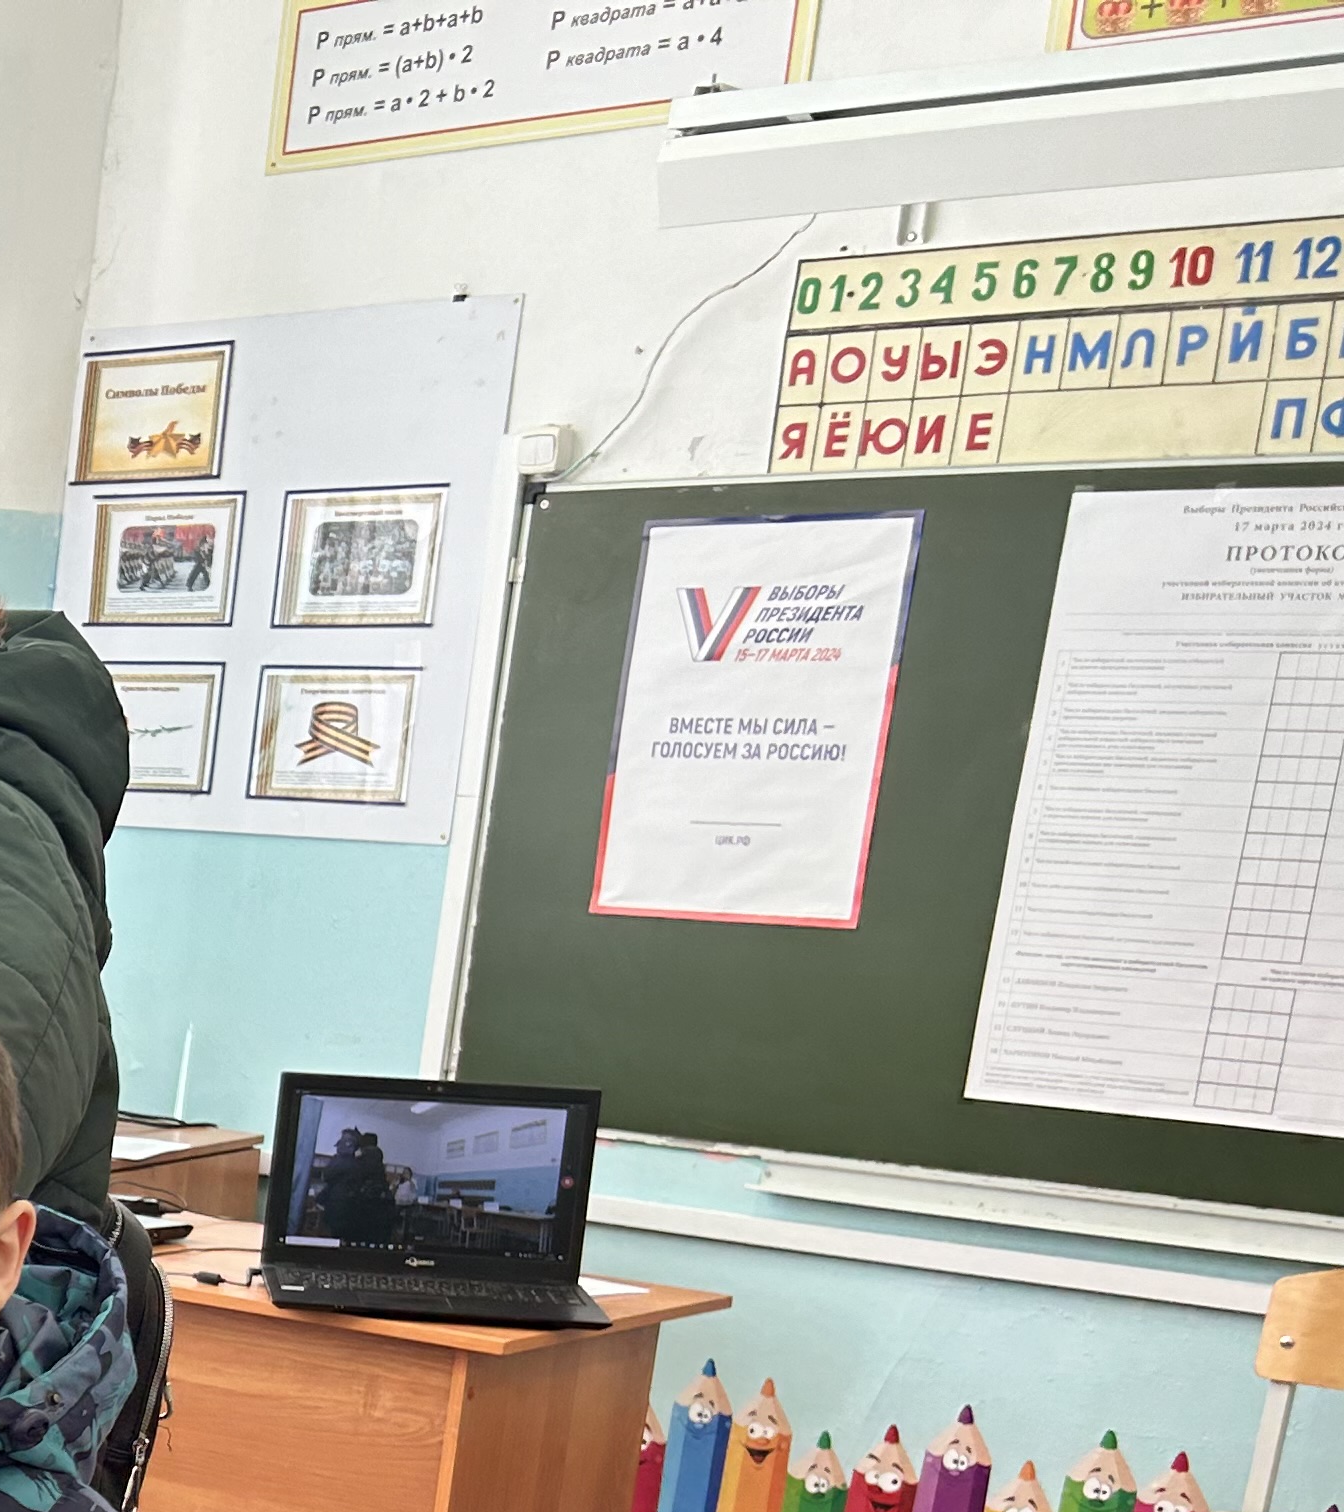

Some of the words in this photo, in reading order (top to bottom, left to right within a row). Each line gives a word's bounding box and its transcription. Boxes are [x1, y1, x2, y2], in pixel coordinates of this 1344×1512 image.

[570, 2, 657, 28] квадрата
[333, 30, 377, 50] прям.
[565, 41, 652, 67] квадрата
[709, 26, 724, 46] 4
[329, 67, 373, 87] прям.
[461, 44, 474, 64] 2
[325, 104, 368, 124] прям.
[418, 88, 430, 108] 2
[483, 78, 495, 98] 2
[796, 277, 822, 315] 0
[829, 274, 847, 312] 1
[858, 271, 883, 311] 2
[895, 268, 922, 308] 3
[930, 264, 957, 304] 4
[971, 261, 1000, 301] 5
[1012, 259, 1040, 299] 6
[1053, 255, 1078, 296] 7
[1090, 252, 1115, 293] 8
[1127, 249, 1155, 291] 9
[1169, 245, 1215, 288] 10
[1235, 240, 1275, 284] 11
[1292, 235, 1343, 280] 12
[788, 348, 817, 386] А
[830, 346, 866, 384] О
[881, 344, 911, 382] У
[919, 340, 962, 381] Ы
[974, 338, 1008, 376] Э
[1022, 334, 1056, 375] Н
[1067, 330, 1113, 372] М
[1120, 328, 1156, 369] Л
[1175, 324, 1209, 367] Р
[1227, 305, 1264, 364] Й
[1285, 317, 1320, 361] Б
[778, 421, 808, 460] Я
[823, 411, 852, 458] Ё
[858, 417, 909, 457] Ю
[913, 414, 947, 454] И
[964, 412, 994, 451] Е
[1269, 397, 1308, 440] П
[767, 584, 847, 602] ВЫБОРЫ
[755, 605, 865, 624] ПРЕЗИДЕНТА
[742, 627, 815, 644] РОССИИ
[768, 648, 812, 662] МАРТА
[812, 647, 842, 662] 2024
[669, 717, 734, 735] ВМЕСТЕ
[737, 717, 768, 735] МЫ
[772, 718, 818, 735] СИЛА
[650, 741, 737, 760] ГОЛОСУЕМ
[741, 743, 761, 760] ЗА
[766, 743, 847, 762] РОССИЮ!
